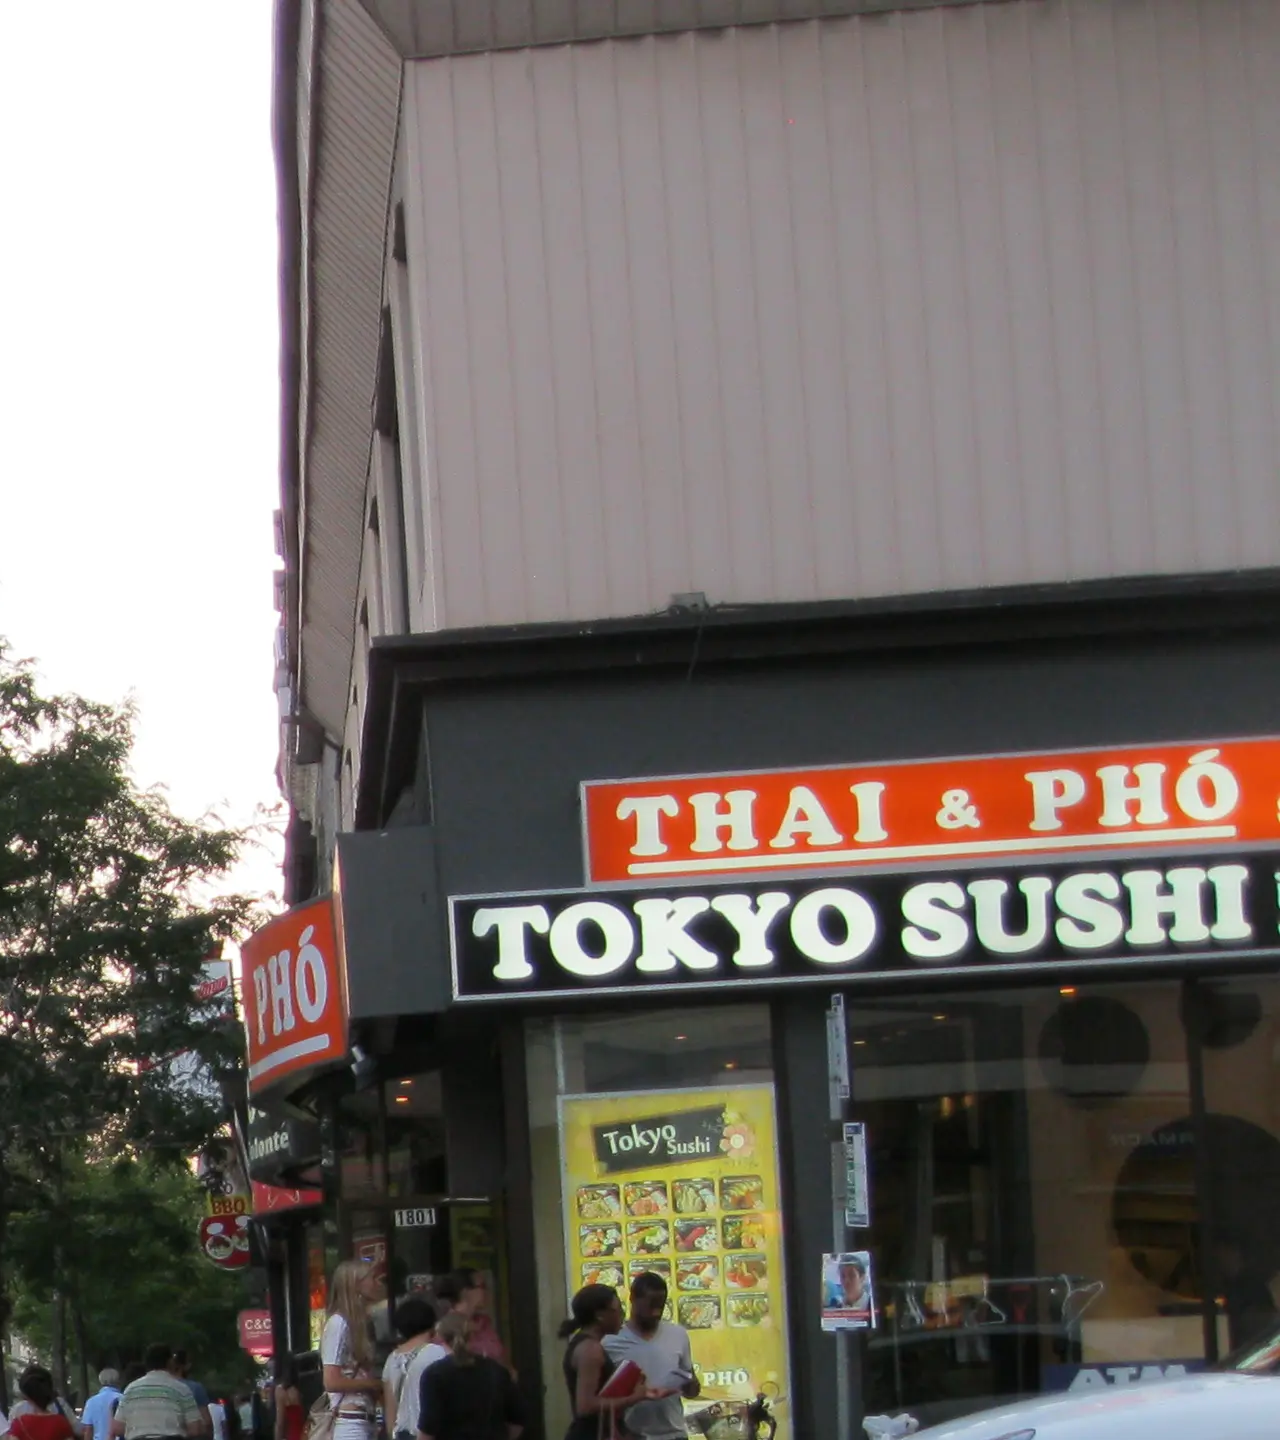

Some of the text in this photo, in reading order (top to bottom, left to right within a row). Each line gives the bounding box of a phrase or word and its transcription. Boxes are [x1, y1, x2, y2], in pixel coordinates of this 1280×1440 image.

[617, 781, 888, 856] THAI
[936, 788, 980, 829] &
[1024, 749, 1239, 831] PHÓ
[473, 865, 1252, 980] TOKYO SUSHI
[254, 925, 327, 1044] PHÓ
[249, 1121, 289, 1160] olonté
[603, 1124, 676, 1154] Tokyo
[667, 1136, 711, 1155] Sushi
[212, 1197, 245, 1215] BBQ
[397, 1208, 435, 1226] 1801
[245, 1319, 272, 1330] C&C
[703, 1367, 749, 1386] PHÓ
